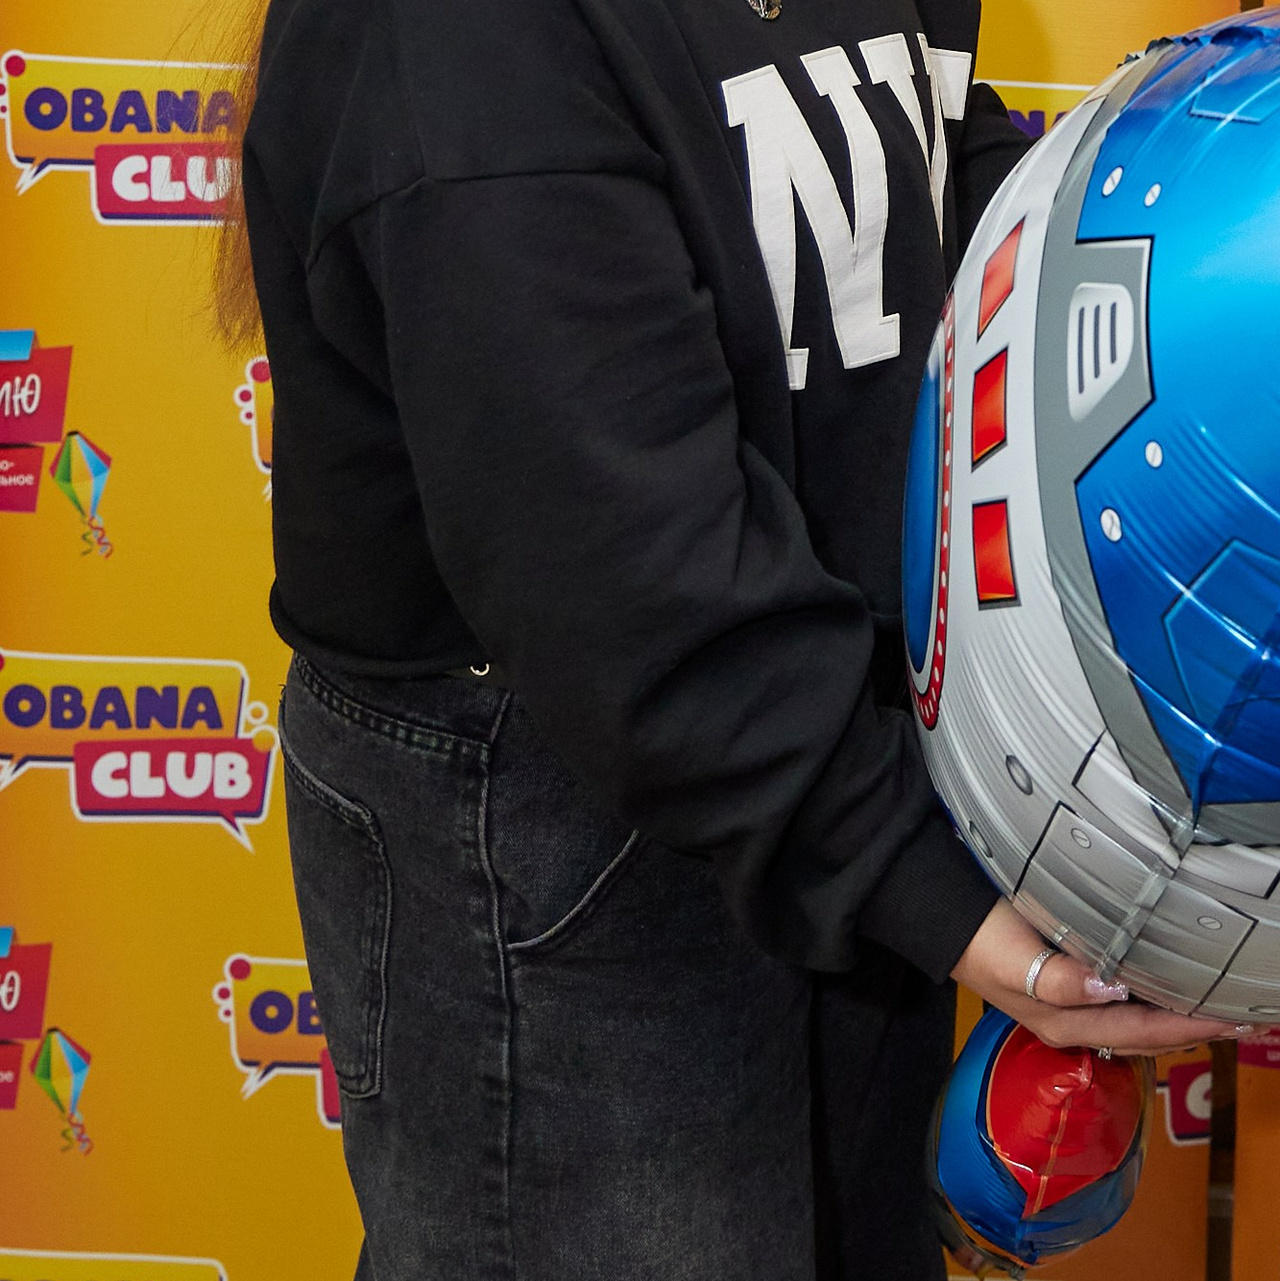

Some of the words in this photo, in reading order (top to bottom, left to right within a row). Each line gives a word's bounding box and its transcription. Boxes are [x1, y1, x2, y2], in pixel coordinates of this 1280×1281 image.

[24, 87, 238, 134] OBANA
[112, 155, 233, 202] CLU
[4, 684, 223, 729] OBANA
[91, 751, 252, 800] CLUB
